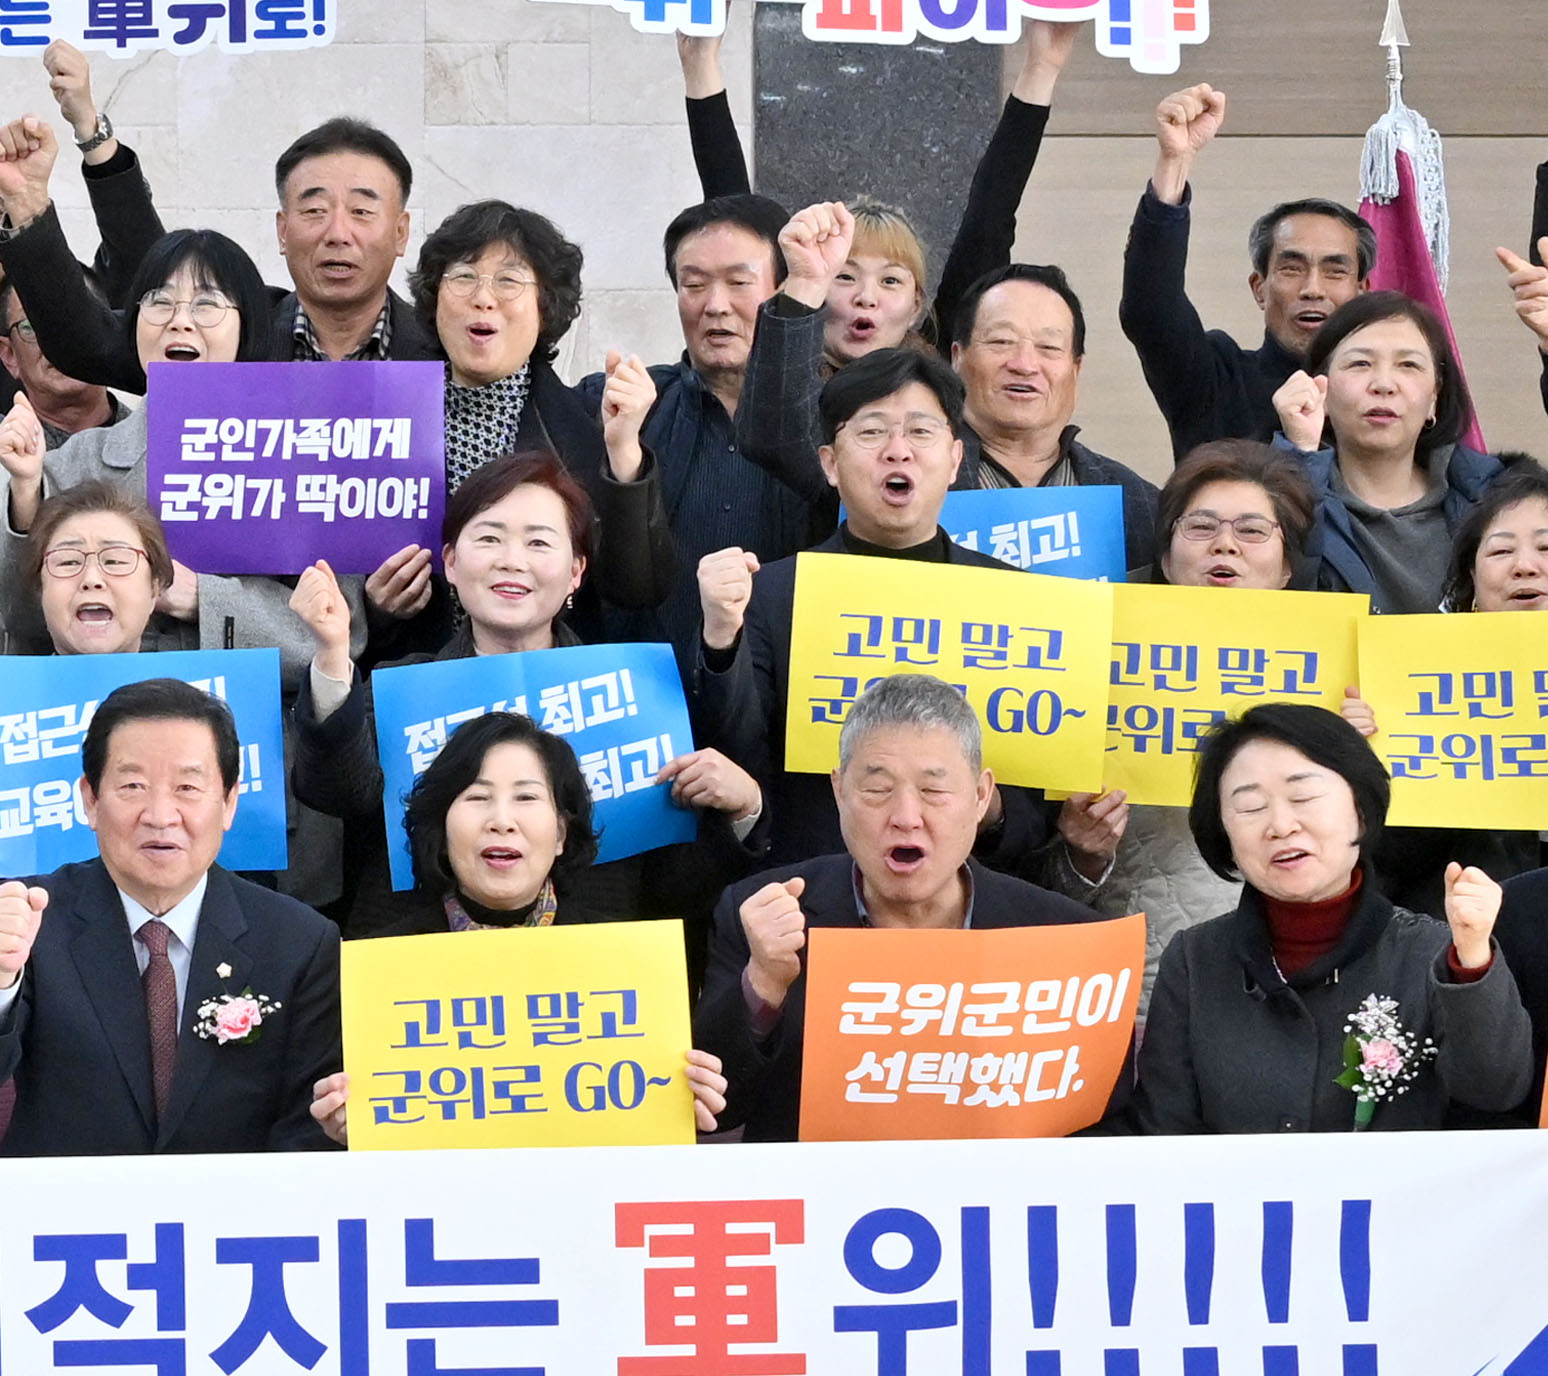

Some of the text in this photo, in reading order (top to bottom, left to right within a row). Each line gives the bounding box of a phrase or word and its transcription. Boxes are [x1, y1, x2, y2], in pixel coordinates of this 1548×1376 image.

[180, 416, 411, 464] 군인가족에게
[159, 474, 431, 524] 군위가 딱이야!
[833, 613, 1067, 672] 고민 말고
[1218, 646, 1321, 697] 말고
[538, 668, 639, 737] 최고!
[1405, 670, 1514, 719] 고민
[390, 988, 646, 1052] 고민 말고
[838, 966, 1131, 1038] 군위군민이
[368, 1066, 548, 1127] 군위로
[844, 1045, 1084, 1109] 선택했다.
